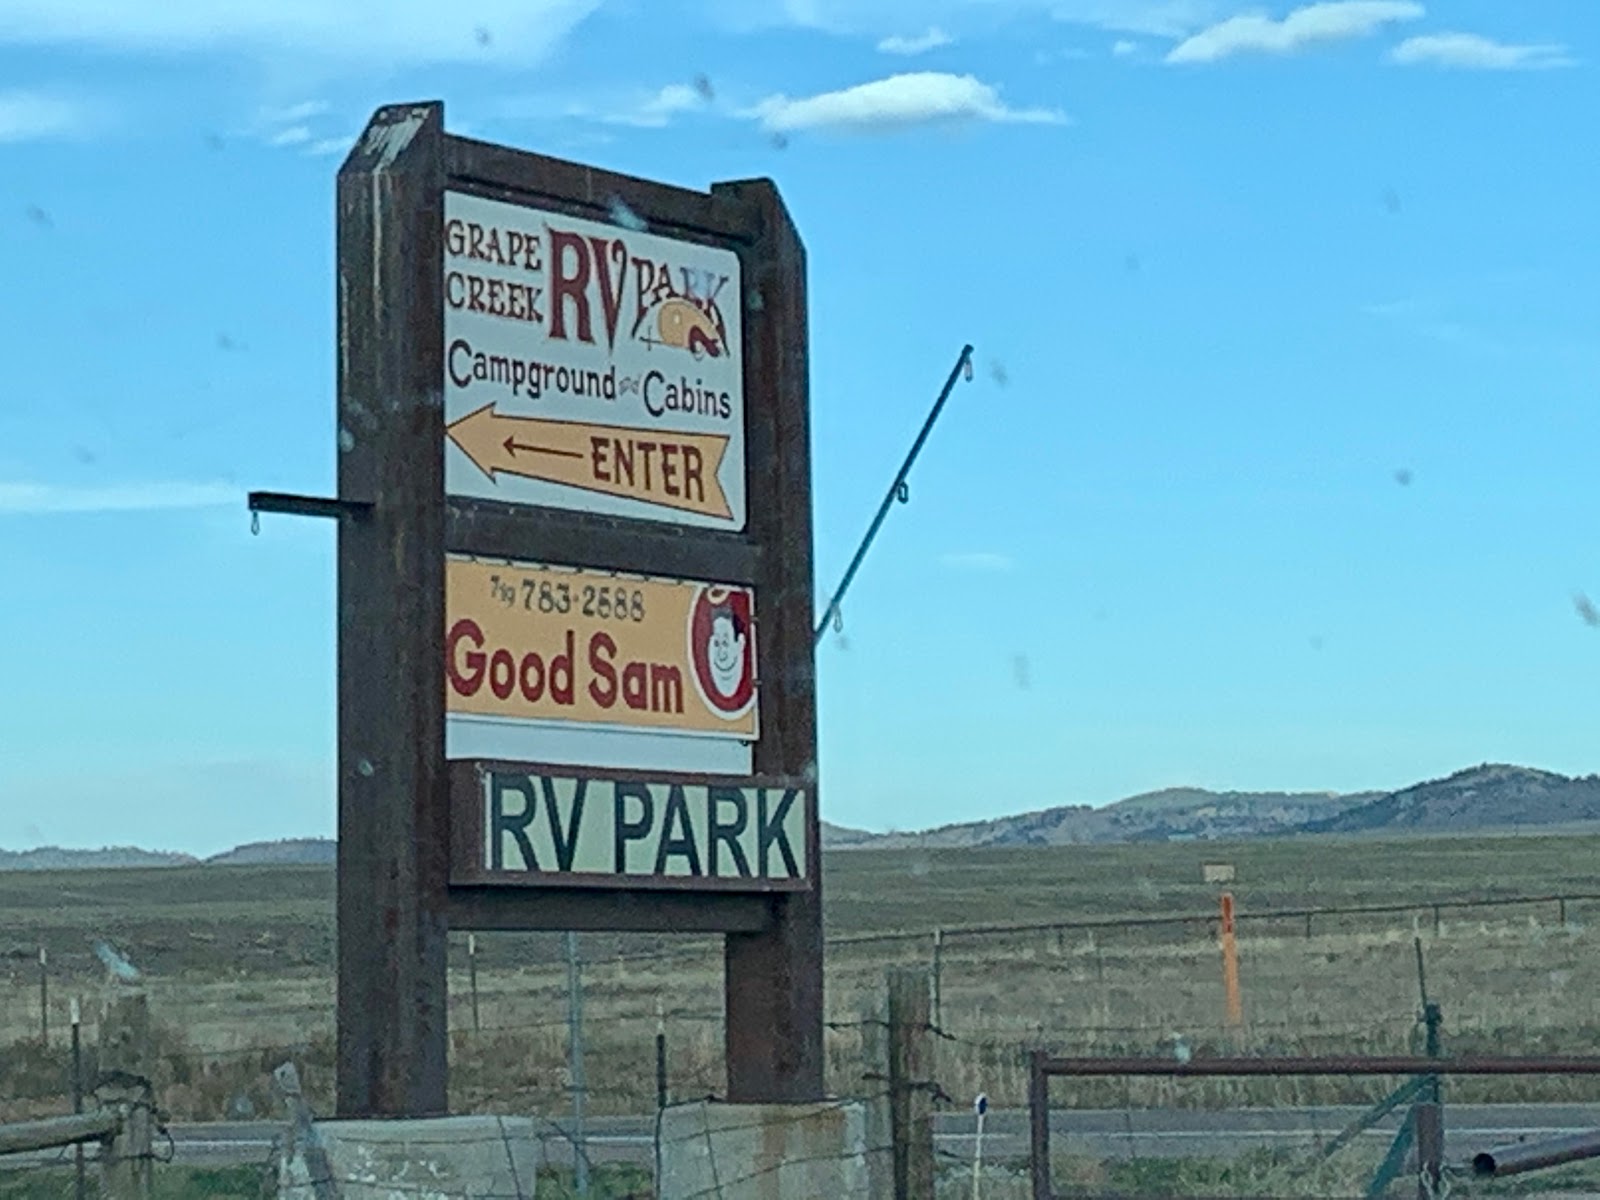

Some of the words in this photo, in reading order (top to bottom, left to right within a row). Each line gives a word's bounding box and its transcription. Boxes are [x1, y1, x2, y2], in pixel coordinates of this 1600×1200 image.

[445, 219, 542, 271] GRAPE
[445, 271, 544, 323] CREEK
[546, 226, 628, 354] RV
[448, 339, 616, 399] Campground
[644, 370, 732, 419] Cabins
[590, 435, 705, 502] ENTER
[446, 618, 575, 705] Good
[588, 631, 685, 714] Sam
[491, 771, 587, 872] RV
[614, 780, 800, 879] PARK
